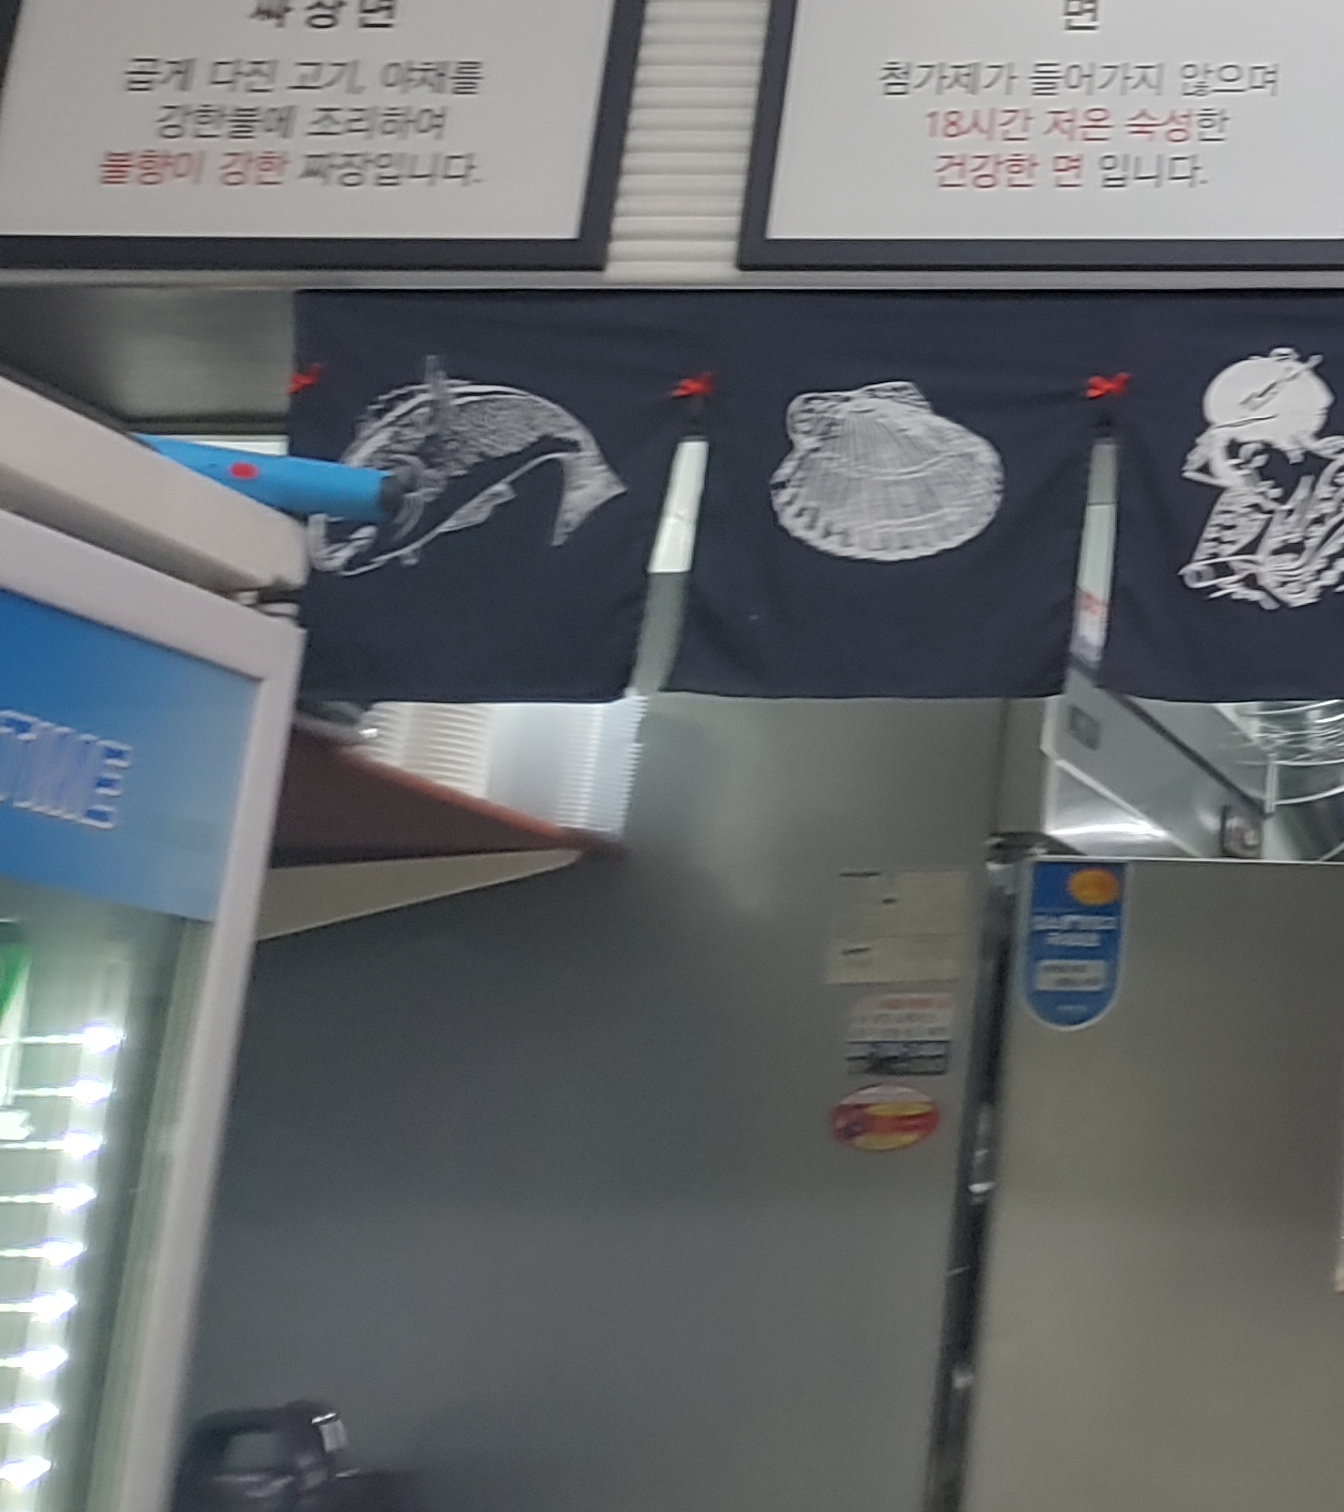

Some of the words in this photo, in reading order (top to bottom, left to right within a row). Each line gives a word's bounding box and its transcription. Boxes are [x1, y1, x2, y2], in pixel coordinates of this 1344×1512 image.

[208, 59, 280, 93] 다진
[379, 60, 484, 95] 야채를
[879, 61, 1019, 97] 첨가제가
[1028, 62, 1164, 96] 들어가지
[1178, 62, 1281, 98] 않으며
[156, 104, 297, 140] 강한불에
[305, 105, 448, 140] 조리하여
[924, 108, 1034, 143] 18시간
[1043, 109, 1117, 141] 저온
[1126, 109, 1231, 143] 숙성한
[99, 150, 208, 186] 불향이
[217, 150, 290, 186] 강한
[932, 153, 1039, 189] 건강한
[1053, 154, 1084, 188] 면
